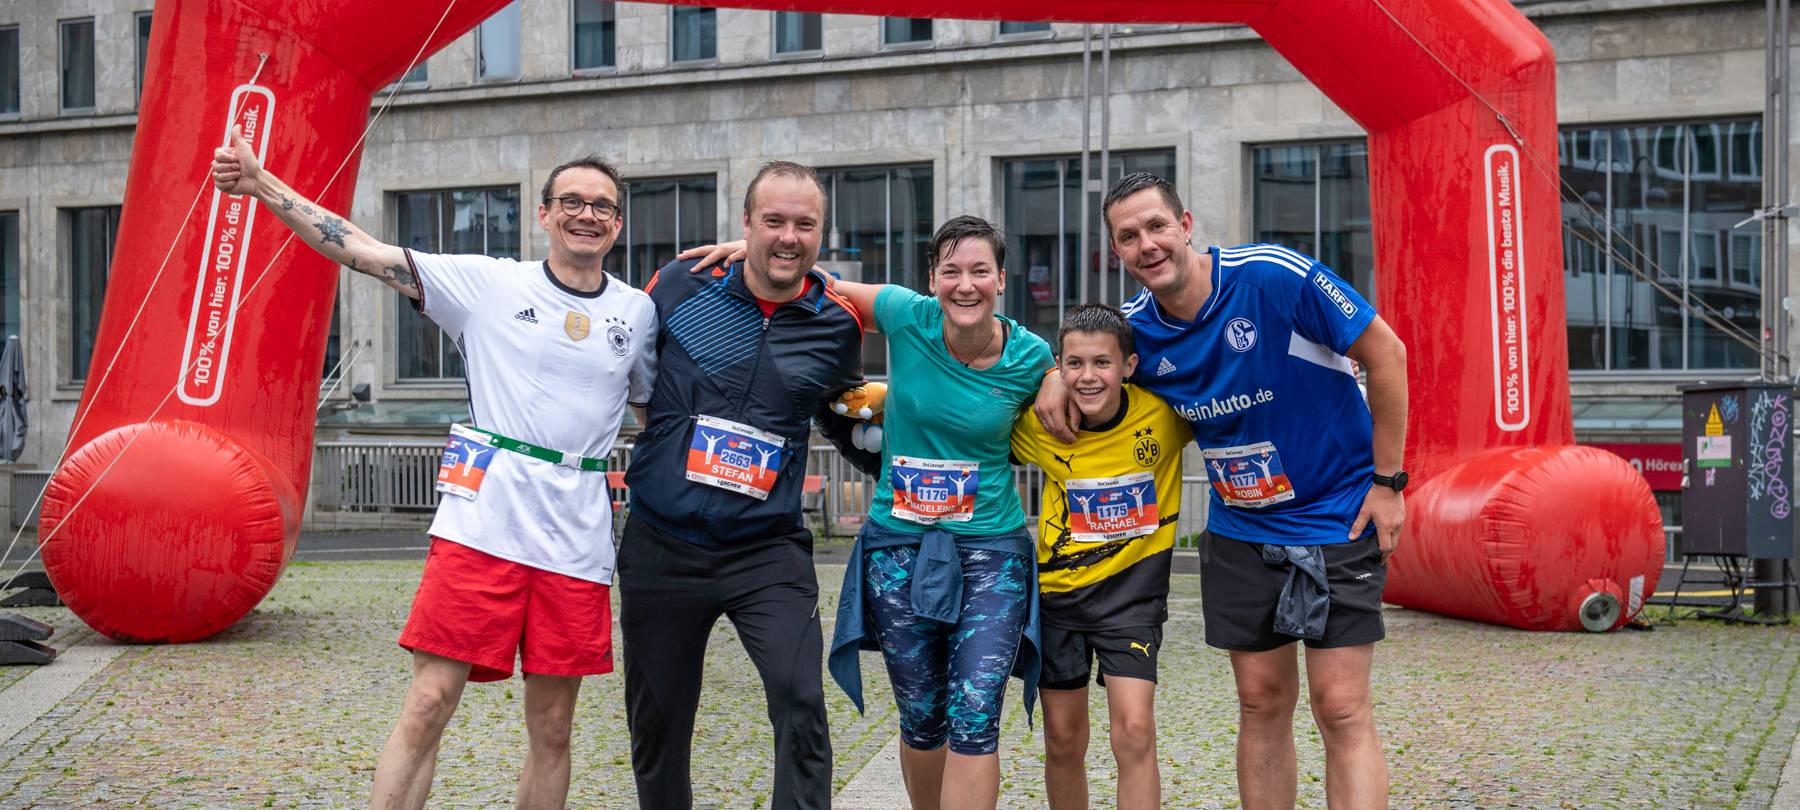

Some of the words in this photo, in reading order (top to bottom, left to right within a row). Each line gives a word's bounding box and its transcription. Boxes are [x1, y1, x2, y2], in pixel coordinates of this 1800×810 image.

[242, 103, 260, 146] usik.
[1498, 161, 1511, 206] Musik.
[225, 199, 242, 225] die
[1500, 208, 1513, 247] beste
[215, 227, 237, 273] 100%
[1502, 248, 1514, 270] die
[209, 276, 228, 309] hier.
[1503, 271, 1515, 313] 100%
[206, 310, 221, 338] von
[1505, 315, 1518, 344] hier.
[194, 342, 216, 387] 100%
[1509, 347, 1519, 370] von
[1507, 374, 1520, 414] 100%
[720, 451, 751, 469] 2663
[1136, 439, 1158, 461] BVB
[711, 464, 754, 483] STEFAN
[1231, 473, 1256, 488] 1177
[918, 489, 948, 501] 1176
[1234, 488, 1264, 499] ROBIN
[1089, 517, 1140, 531] RAPHAEL
[1097, 505, 1127, 518] 1175
